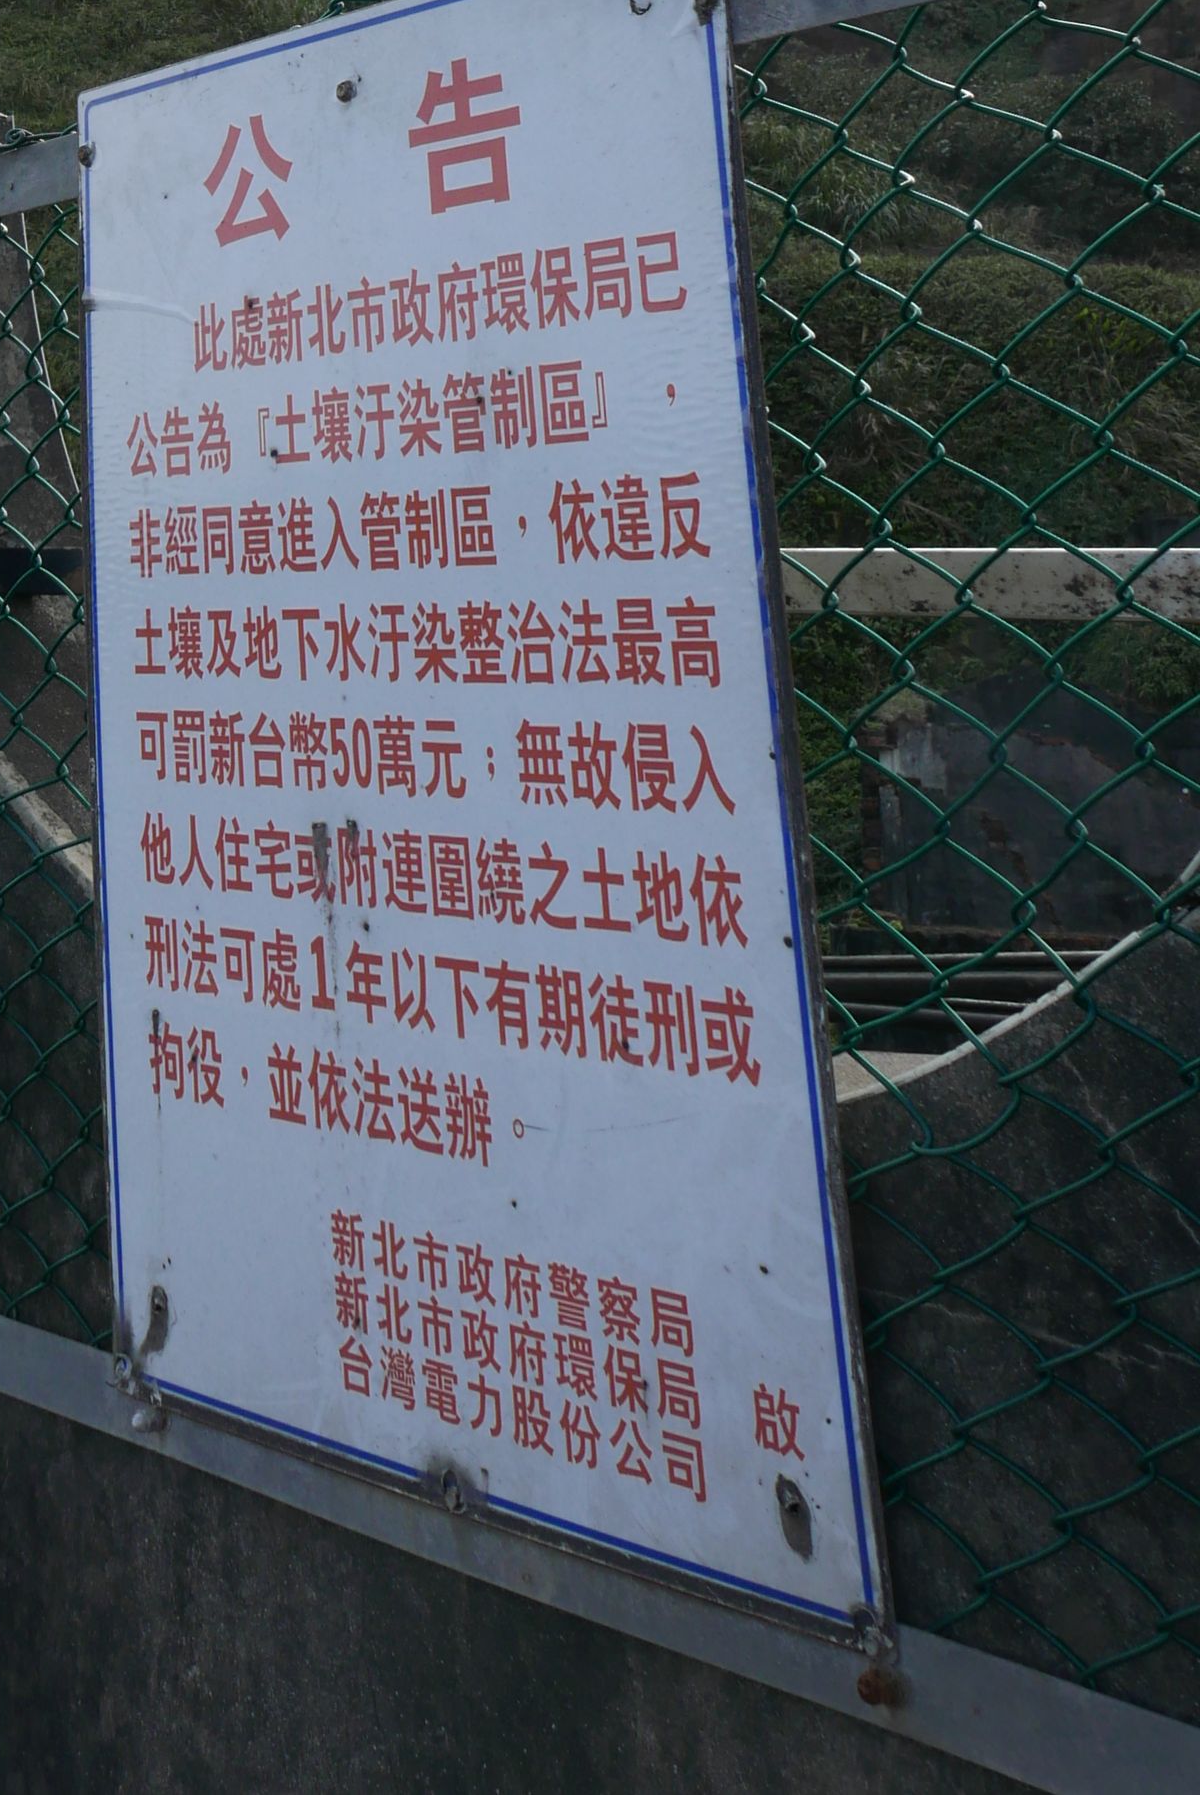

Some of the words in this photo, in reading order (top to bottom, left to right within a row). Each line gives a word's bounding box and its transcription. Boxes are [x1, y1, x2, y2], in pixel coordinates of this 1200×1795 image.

[204, 58, 521, 247] 公告
[194, 231, 688, 373] 此處新北市政府環保局已
[141, 811, 749, 949] 他人住宅或附連圍繞之土地依
[144, 915, 761, 1087] 刑法可處1年以下有期徒刑或
[330, 1209, 695, 1358] 新北市政府警察局
[335, 1272, 701, 1430] 新北市政府環保局
[338, 1336, 708, 1503] 台灣電力股份公司
